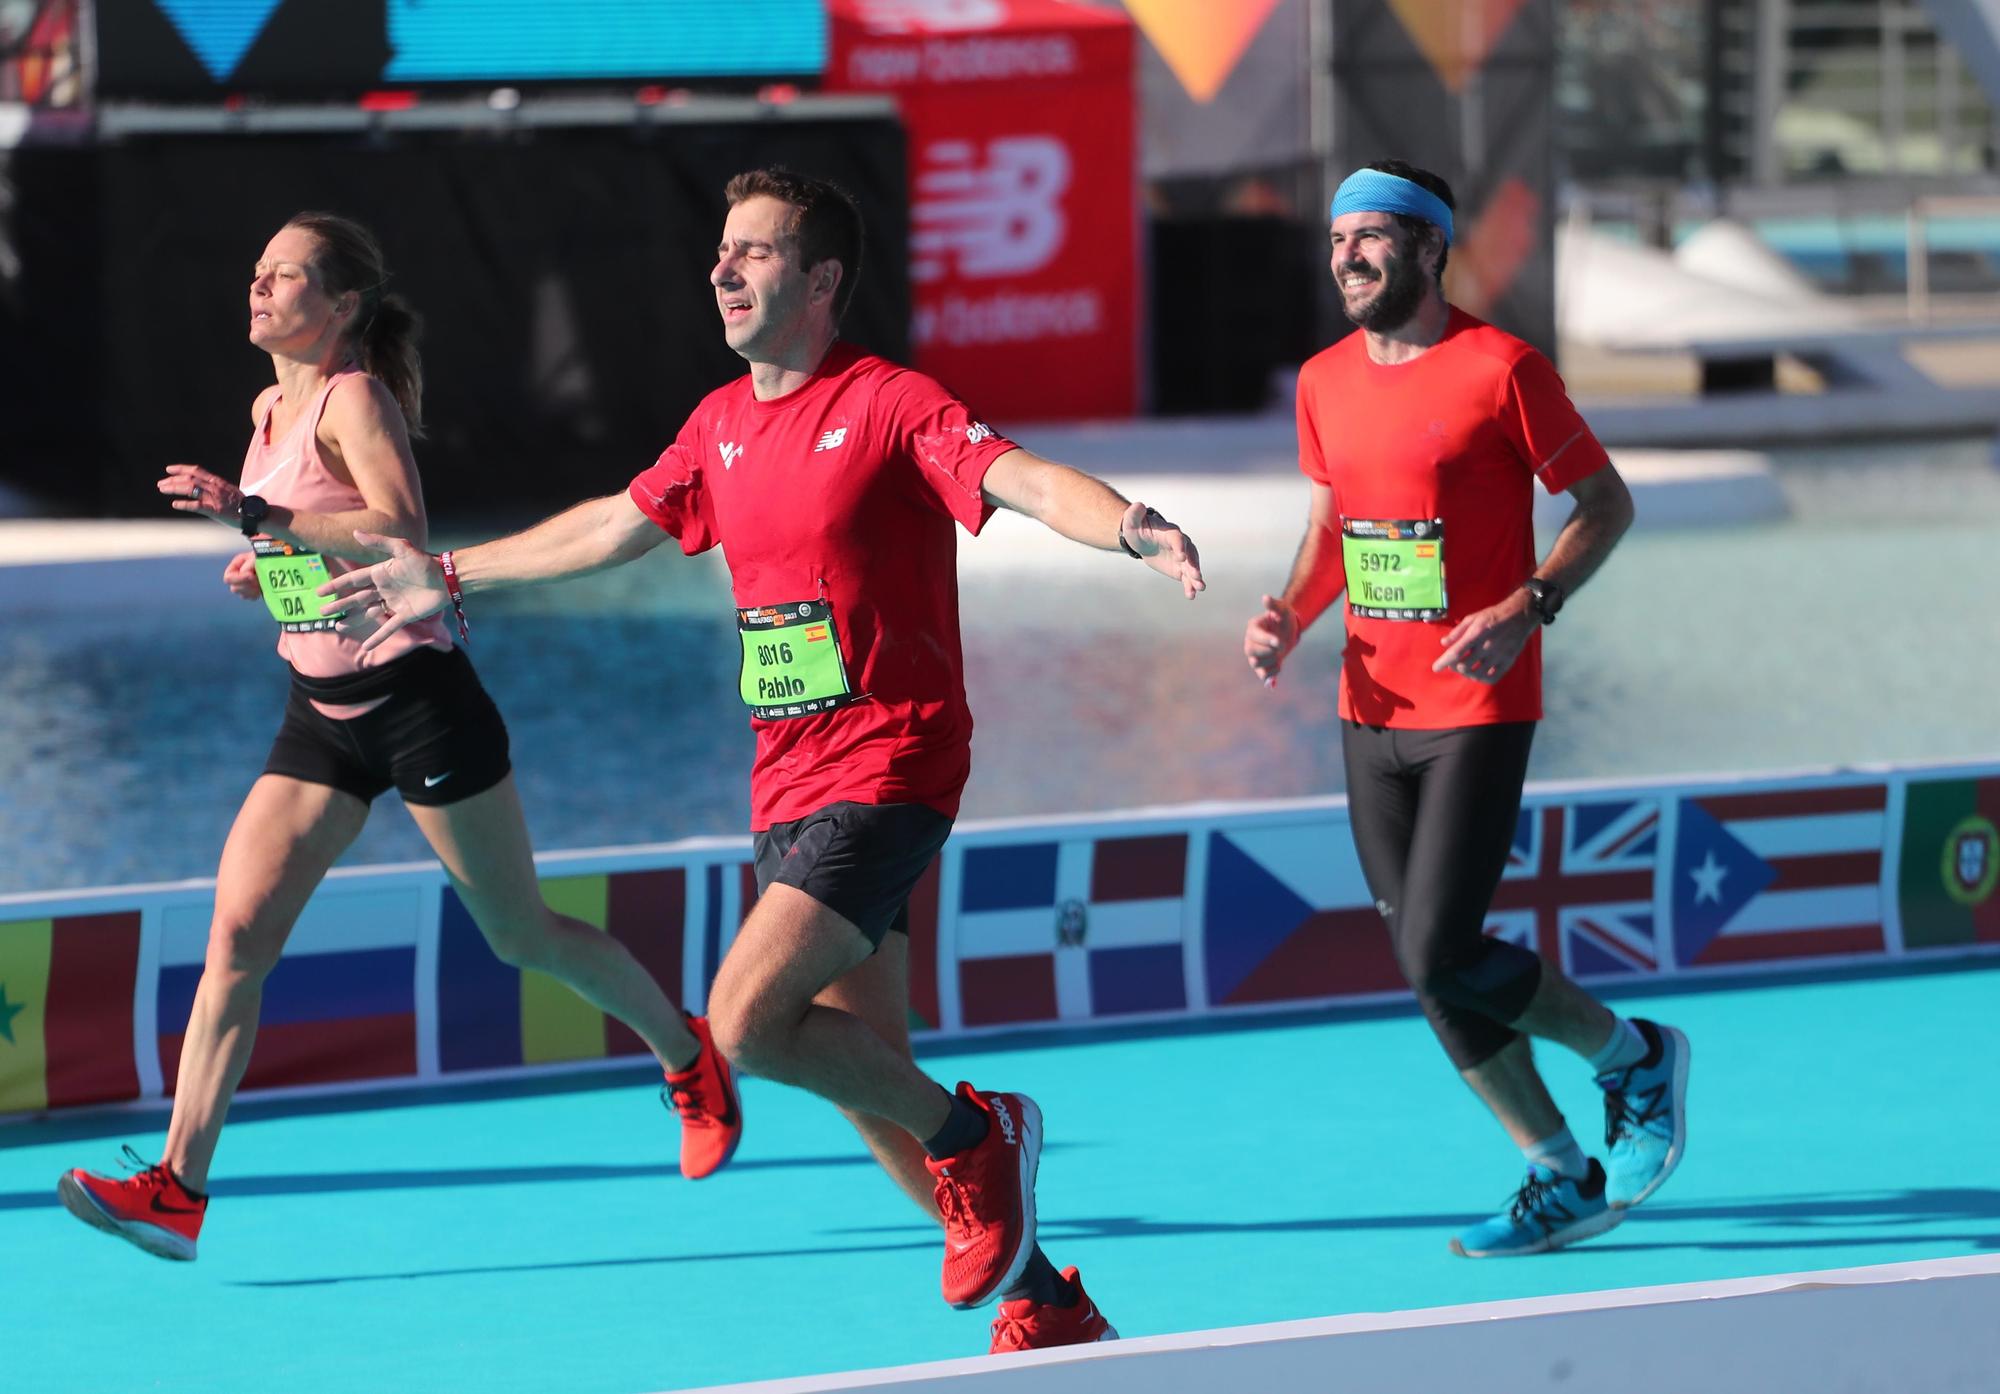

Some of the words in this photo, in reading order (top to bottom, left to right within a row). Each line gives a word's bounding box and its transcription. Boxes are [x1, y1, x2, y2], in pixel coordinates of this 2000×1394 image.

[1360, 553, 1401, 572] 5972
[269, 568, 305, 589] 6216
[1362, 581, 1405, 602] Vicen
[758, 641, 793, 666] 8016
[759, 675, 806, 700] Pablo
[990, 1096, 1016, 1145] HOKA
